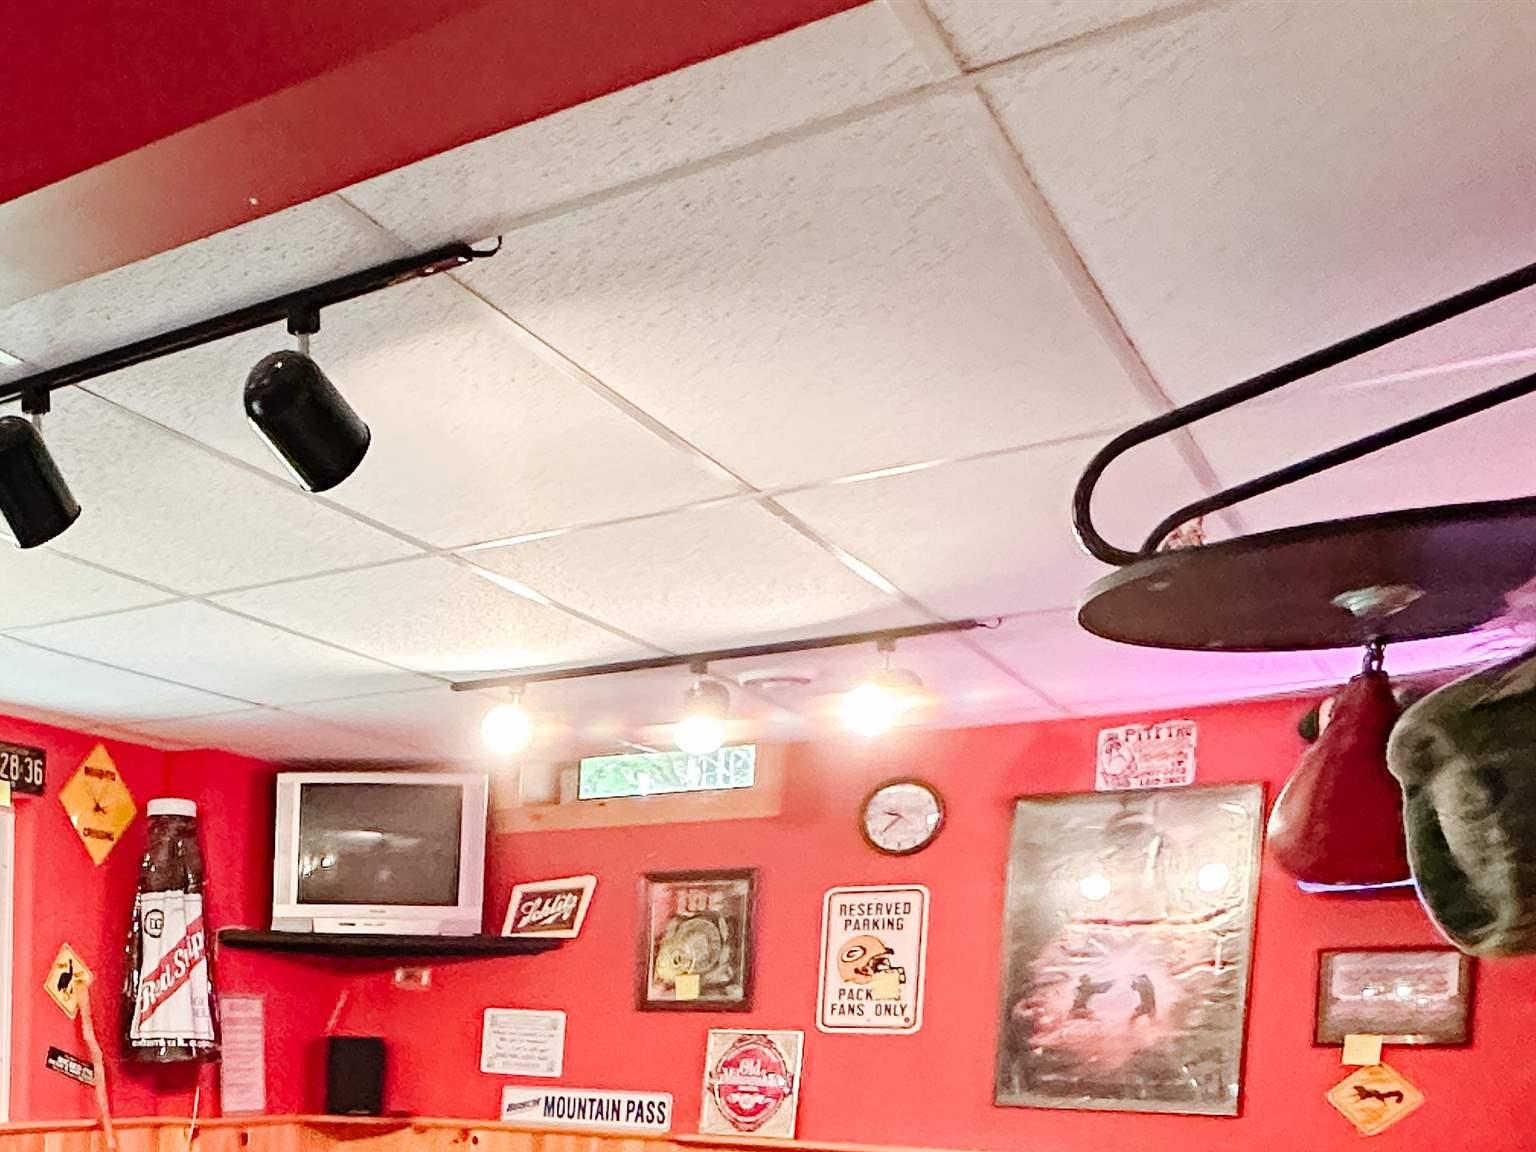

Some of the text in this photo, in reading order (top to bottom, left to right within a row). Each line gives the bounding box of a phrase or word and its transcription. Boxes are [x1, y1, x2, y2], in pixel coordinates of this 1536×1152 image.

[839, 902, 911, 917] RESERVED
[844, 917, 905, 931] PARKING
[830, 1003, 908, 1017] FANS ONLY
[543, 1095, 621, 1122] MOUNTAIN
[625, 1099, 667, 1125] PASS
